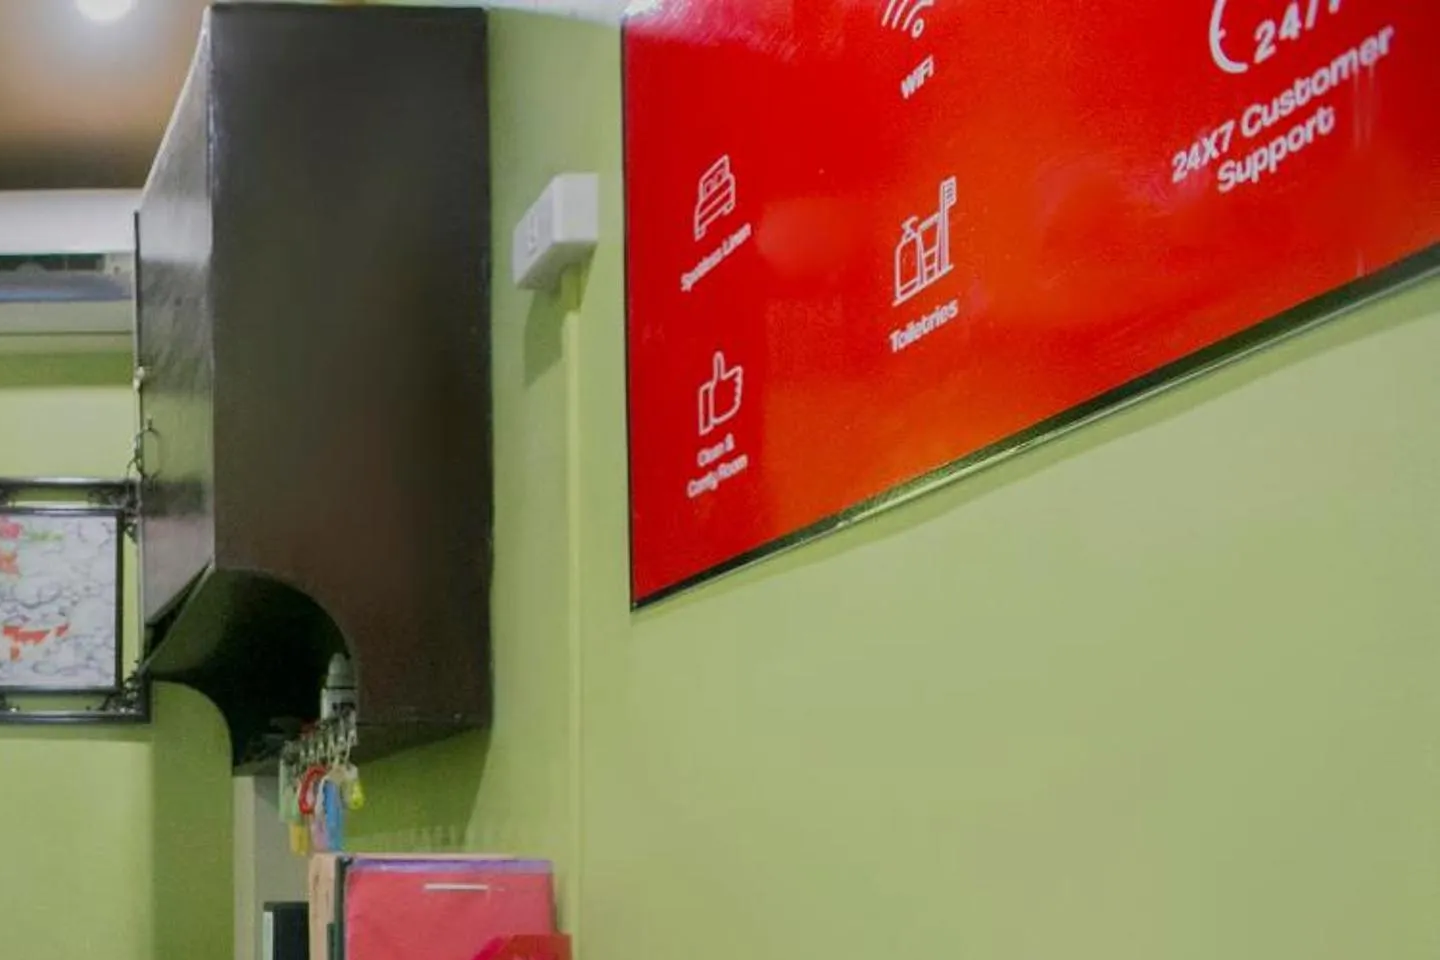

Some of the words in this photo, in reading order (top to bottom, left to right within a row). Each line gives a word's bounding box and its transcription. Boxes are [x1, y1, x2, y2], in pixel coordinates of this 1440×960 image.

[1172, 119, 1235, 183] 24X7
[1240, 26, 1394, 137] Customer
[1217, 106, 1335, 193] Support
